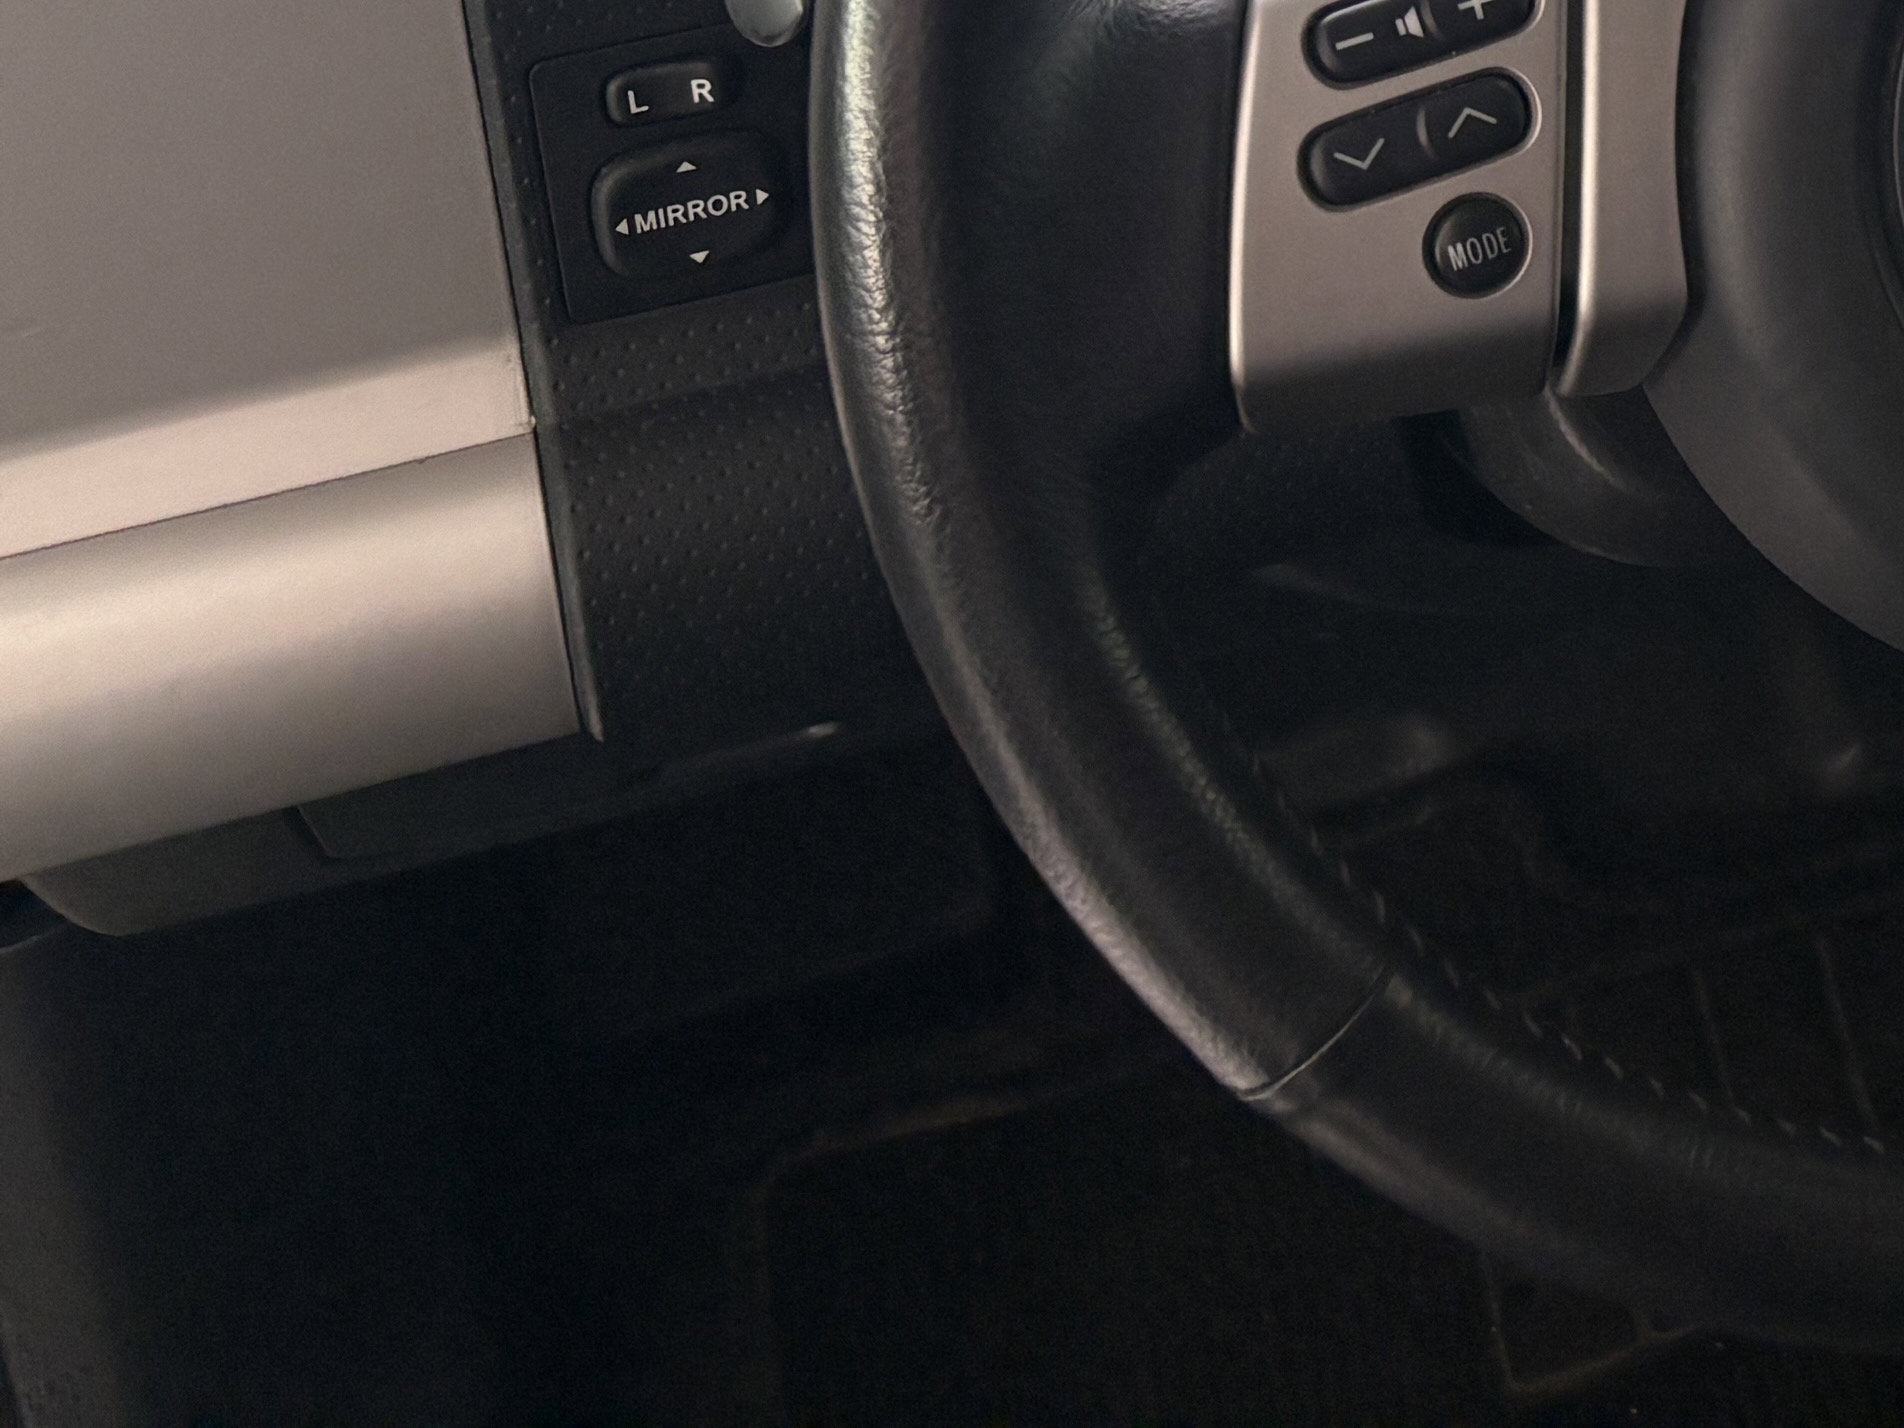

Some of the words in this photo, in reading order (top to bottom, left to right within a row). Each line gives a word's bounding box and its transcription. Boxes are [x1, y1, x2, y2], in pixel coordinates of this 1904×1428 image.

[626, 89, 650, 115] L
[690, 78, 715, 104] R
[633, 189, 750, 235] MIRROR
[1447, 225, 1513, 272] MODE
